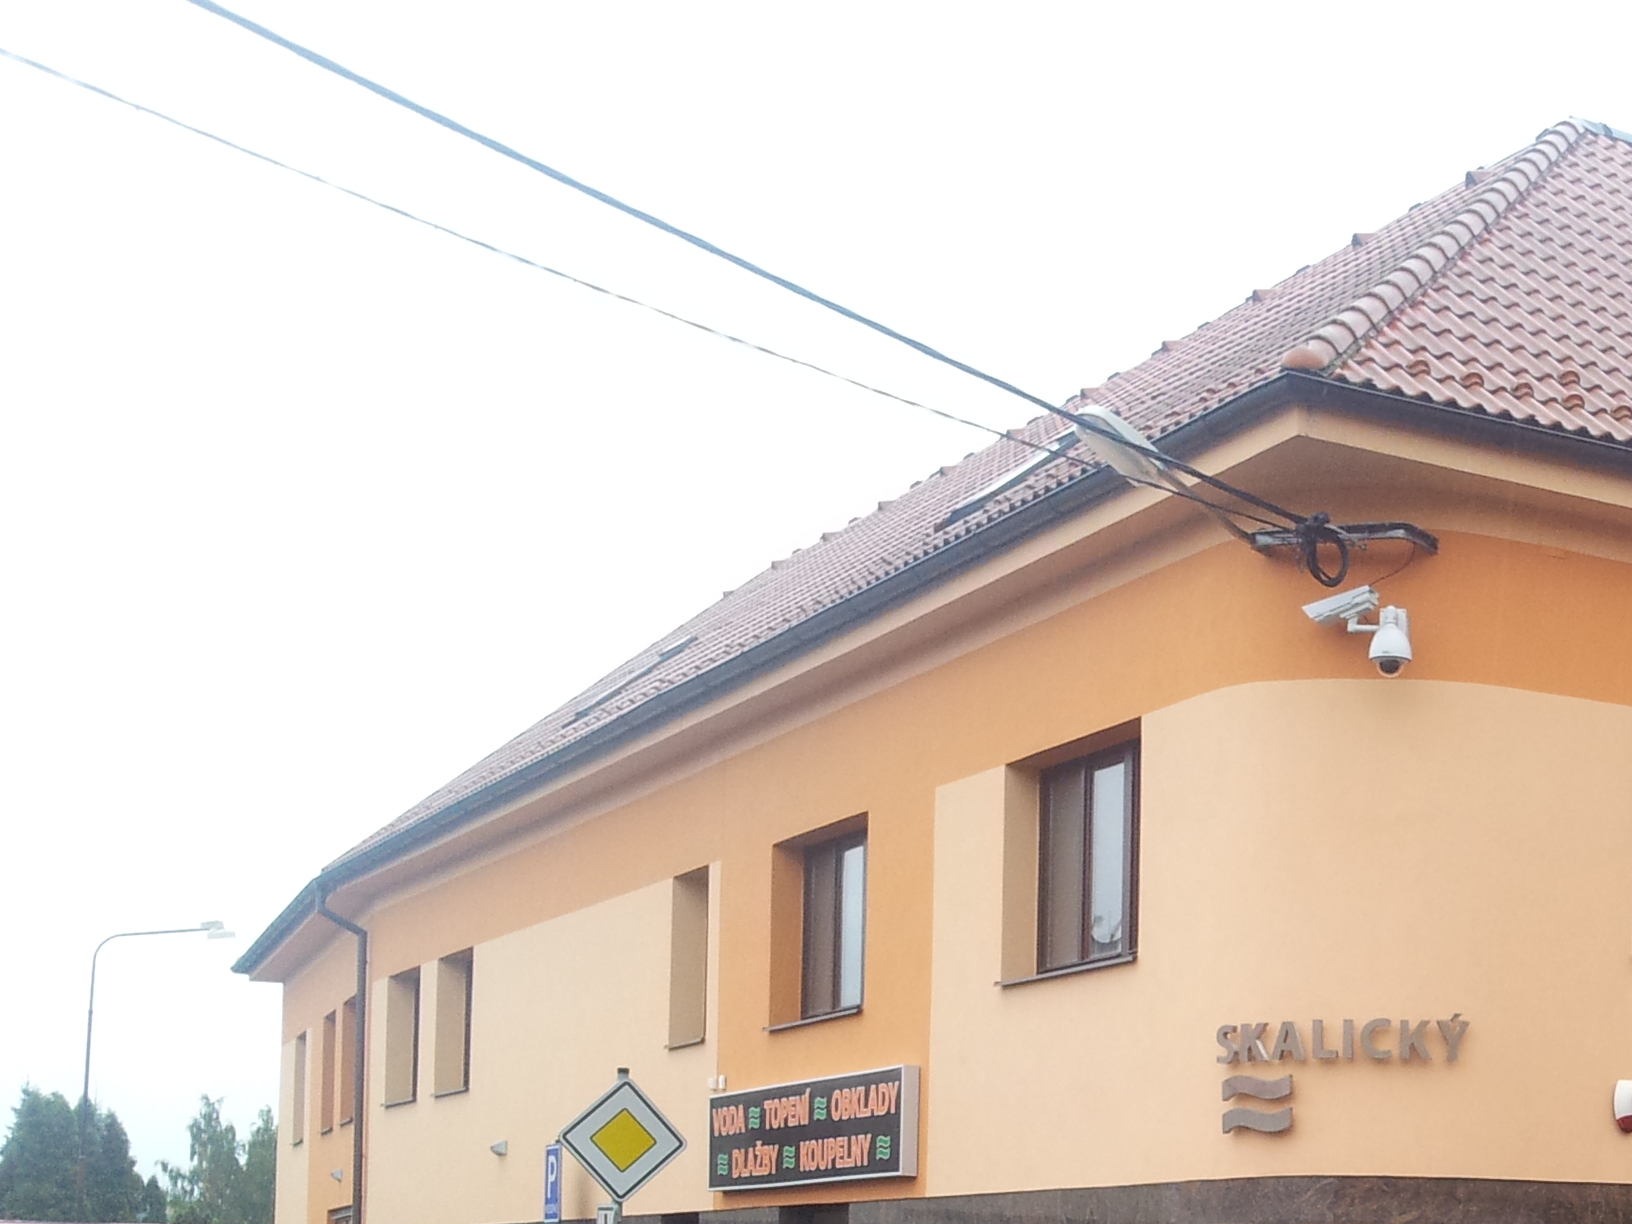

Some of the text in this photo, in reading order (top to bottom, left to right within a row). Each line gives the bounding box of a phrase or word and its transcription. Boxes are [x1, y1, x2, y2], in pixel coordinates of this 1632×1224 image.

[1216, 1013, 1470, 1064] SKALICKÝ
[712, 1081, 900, 1137] VODA TOPENÍ OBKLADY
[547, 1155, 557, 1199] P
[731, 1133, 872, 1179] DLAŽBY KOUPELNY
